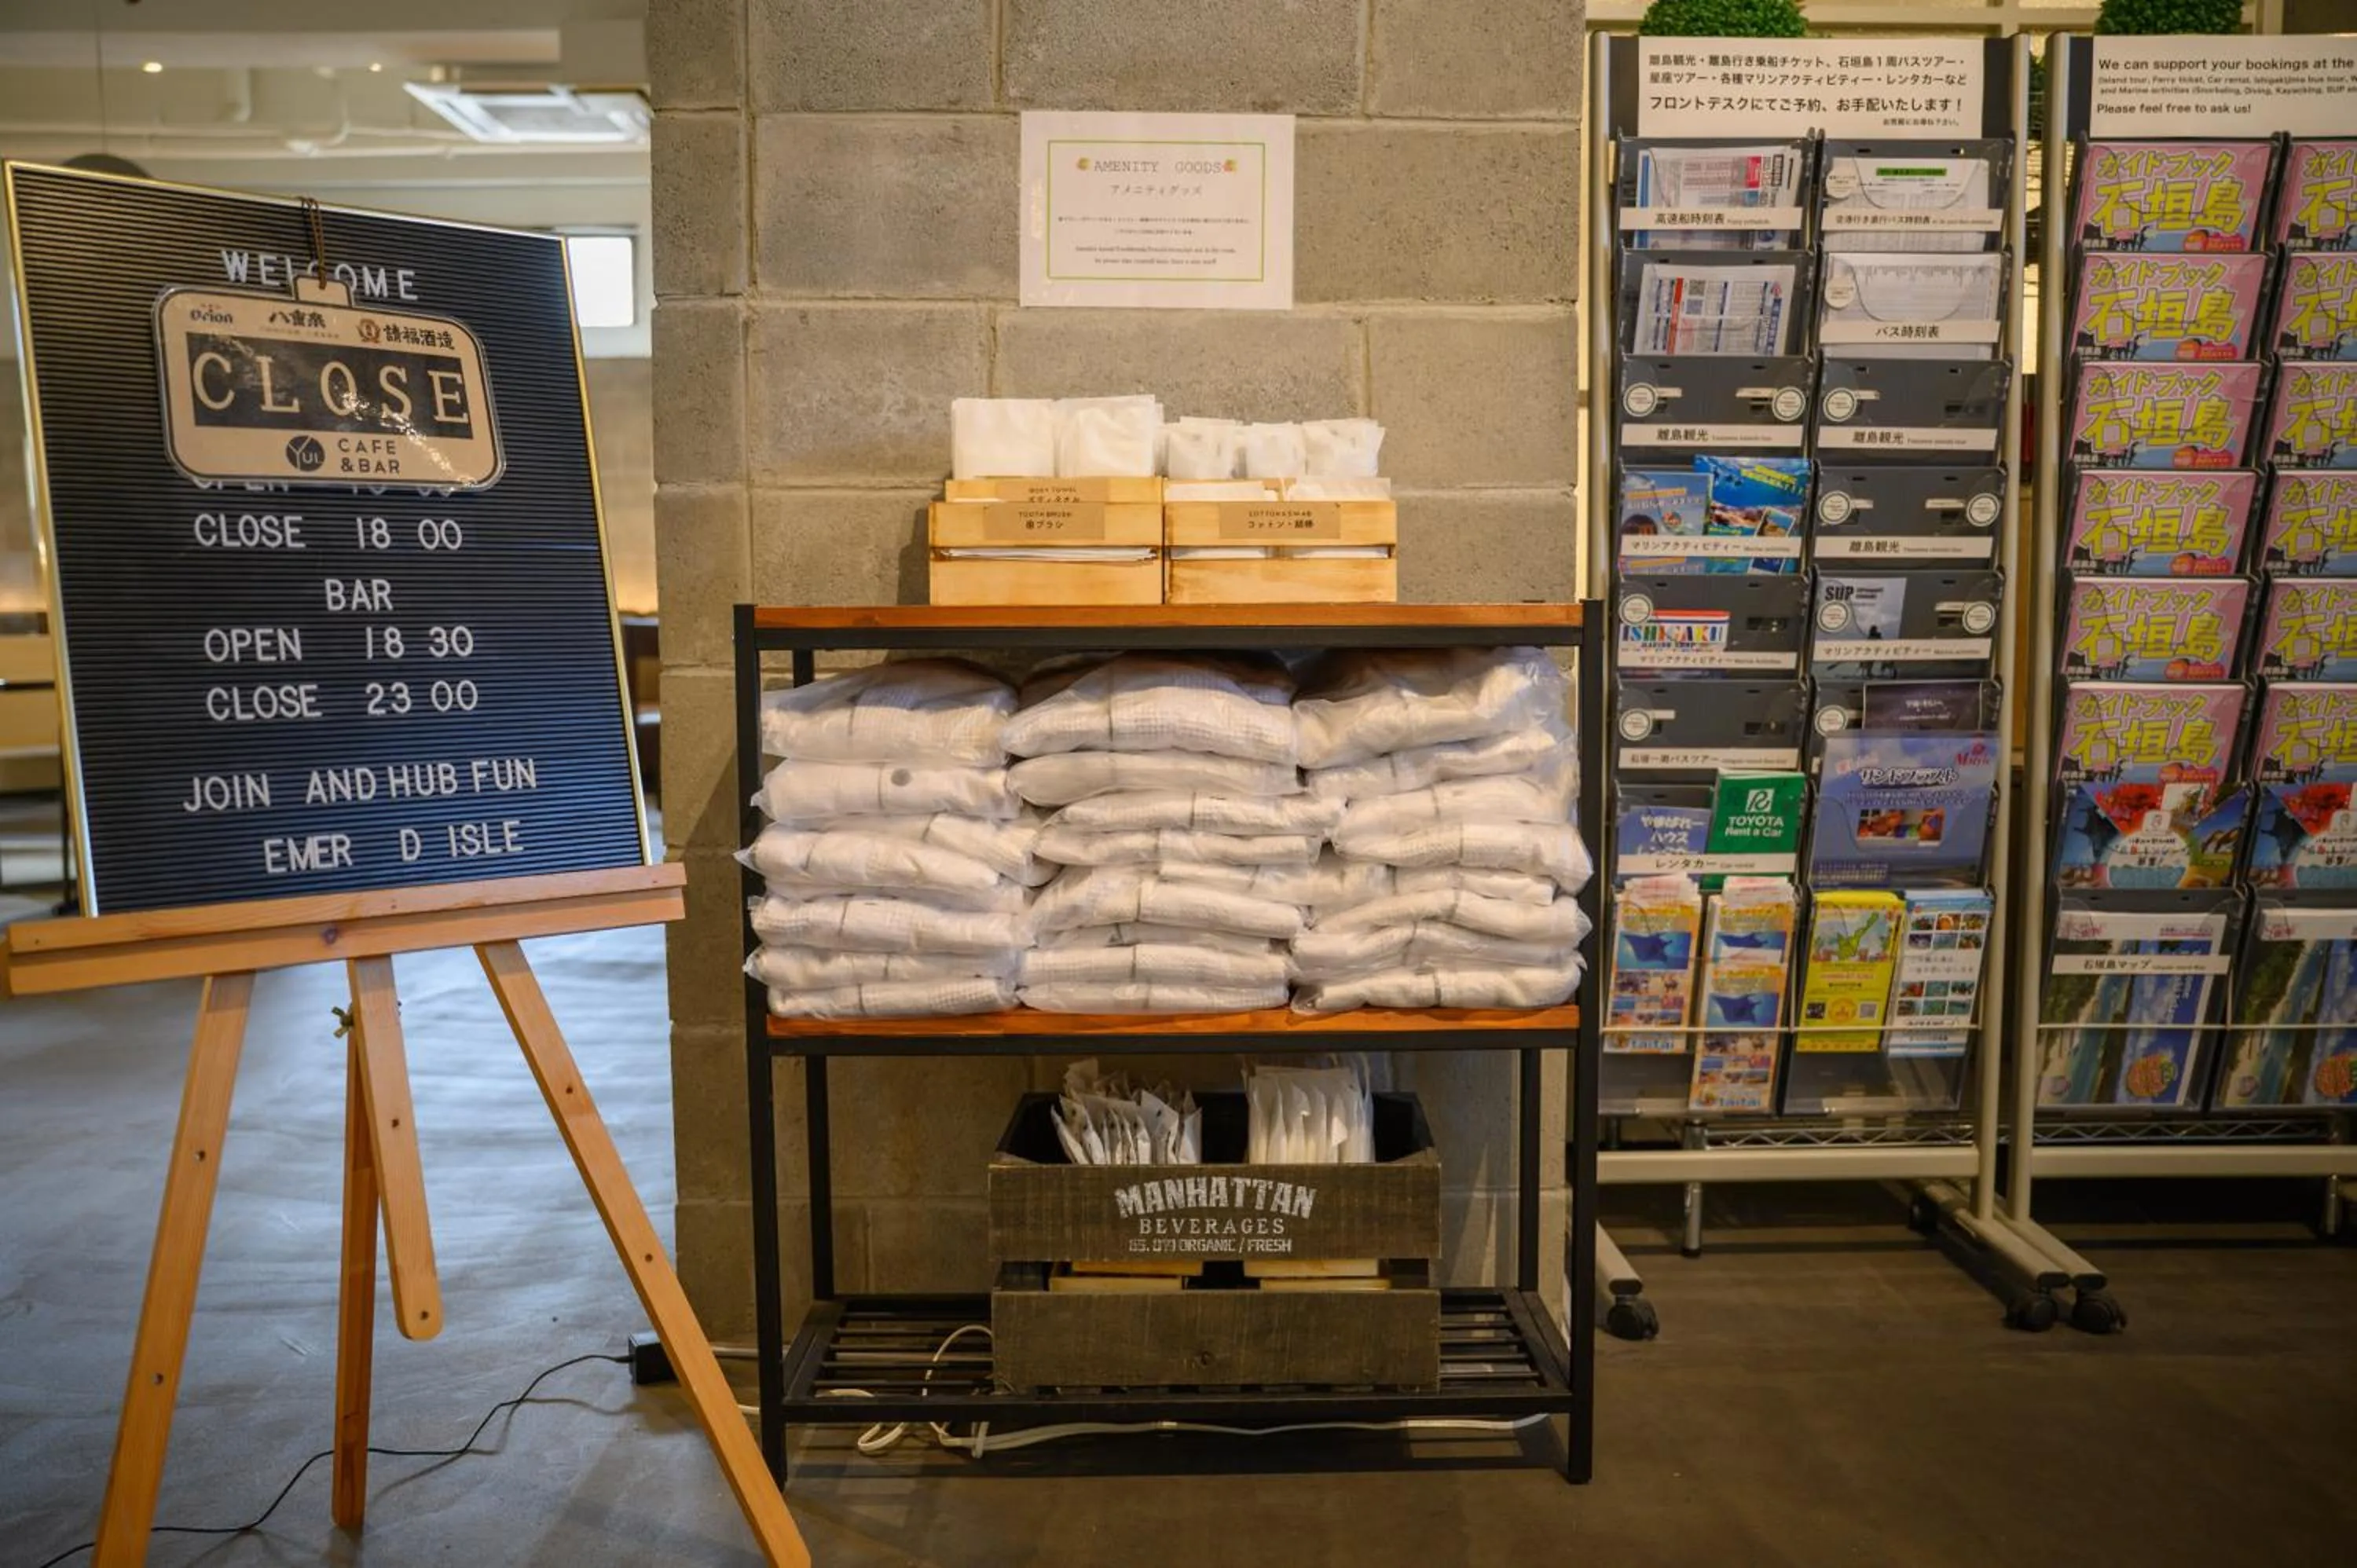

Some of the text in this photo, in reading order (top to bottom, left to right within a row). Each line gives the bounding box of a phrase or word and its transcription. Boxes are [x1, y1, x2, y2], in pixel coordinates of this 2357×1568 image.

[2099, 58, 2355, 72] We can support your bookings at the
[2097, 103, 2252, 114] Please feel free to ask us!
[1094, 161, 1222, 174] AMENITY GOODS
[2097, 150, 2235, 178] ガイドブック
[2091, 176, 2245, 234] 石垣島
[2089, 258, 2227, 288] ガイドブック
[2083, 287, 2239, 346] 石垣島
[1875, 324, 1940, 339] バス時刻表
[192, 351, 470, 424] CLOSE
[2088, 369, 2223, 397] ガイドブック
[1656, 427, 1710, 441] 離島観光
[2080, 395, 2235, 452] 石垣島
[338, 438, 397, 455] CAFE
[2085, 477, 2222, 505] ガイドブック
[194, 513, 463, 550] CLOSE 18 00
[2080, 503, 2233, 559] 石垣島
[324, 578, 394, 611] BAR
[1824, 584, 1854, 602] SUP
[2080, 586, 2215, 614] ガイドブック
[204, 625, 474, 661] OPEN 18 30
[2075, 611, 2224, 665] 石垣島
[207, 680, 478, 721] CLOSE 23 00
[2073, 691, 2209, 718] ガイドブック
[2069, 716, 2221, 771] 石垣島
[183, 758, 537, 812] JOIN AND HUB FUN
[1725, 827, 1750, 837] Rent
[1762, 827, 1783, 837] Car
[1728, 816, 1784, 828] TOYOTA
[263, 820, 525, 874] EMER D ISLE
[1655, 859, 1717, 869] レンタカー
[1114, 1176, 1317, 1219] MANHATTAN
[1139, 1218, 1285, 1235] BEVERAGES
[1179, 1239, 1236, 1251] ORGANIC
[1248, 1239, 1292, 1251] FRESH
